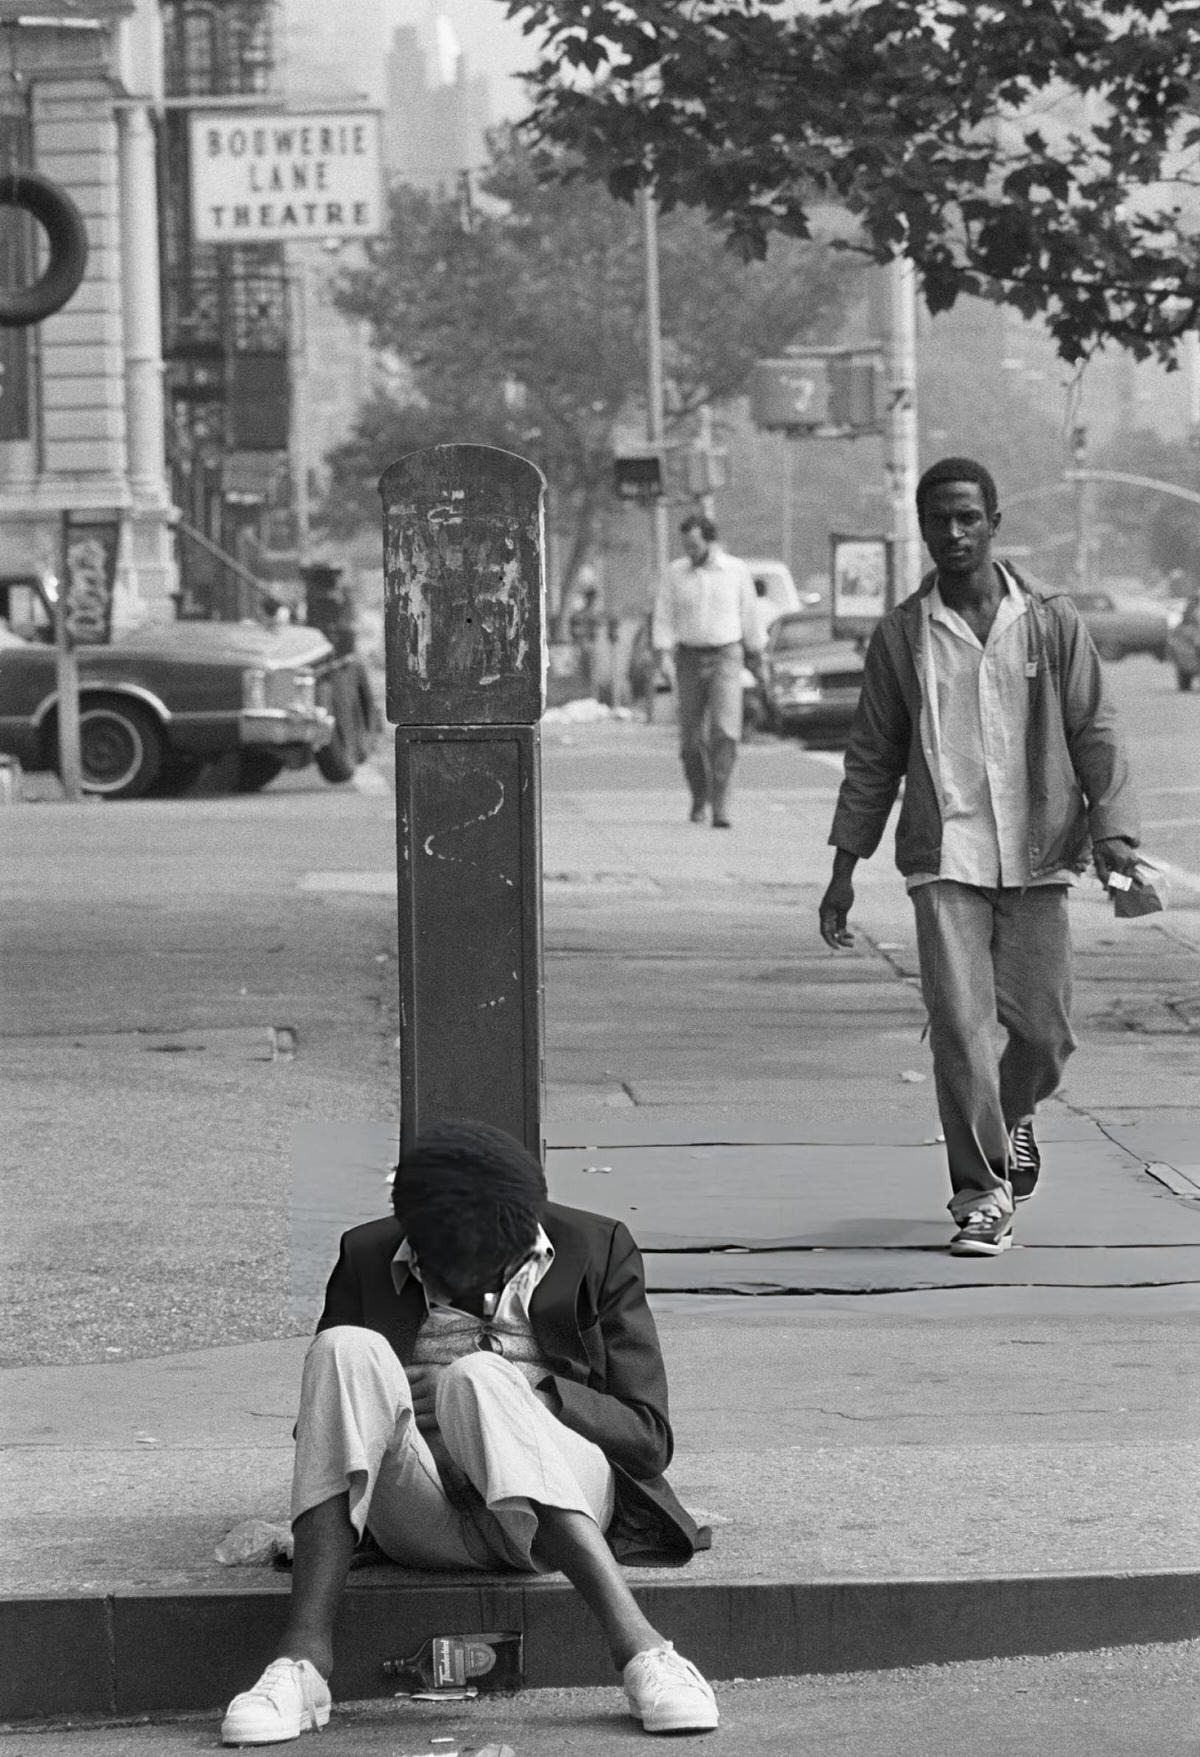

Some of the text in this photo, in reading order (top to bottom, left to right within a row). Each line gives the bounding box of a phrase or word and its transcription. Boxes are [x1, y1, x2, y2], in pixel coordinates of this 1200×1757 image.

[208, 126, 366, 158] BOUWERIE
[249, 161, 329, 193] LANE
[211, 201, 368, 228] THEATRE
[439, 1639, 454, 1685] Thunderbird
